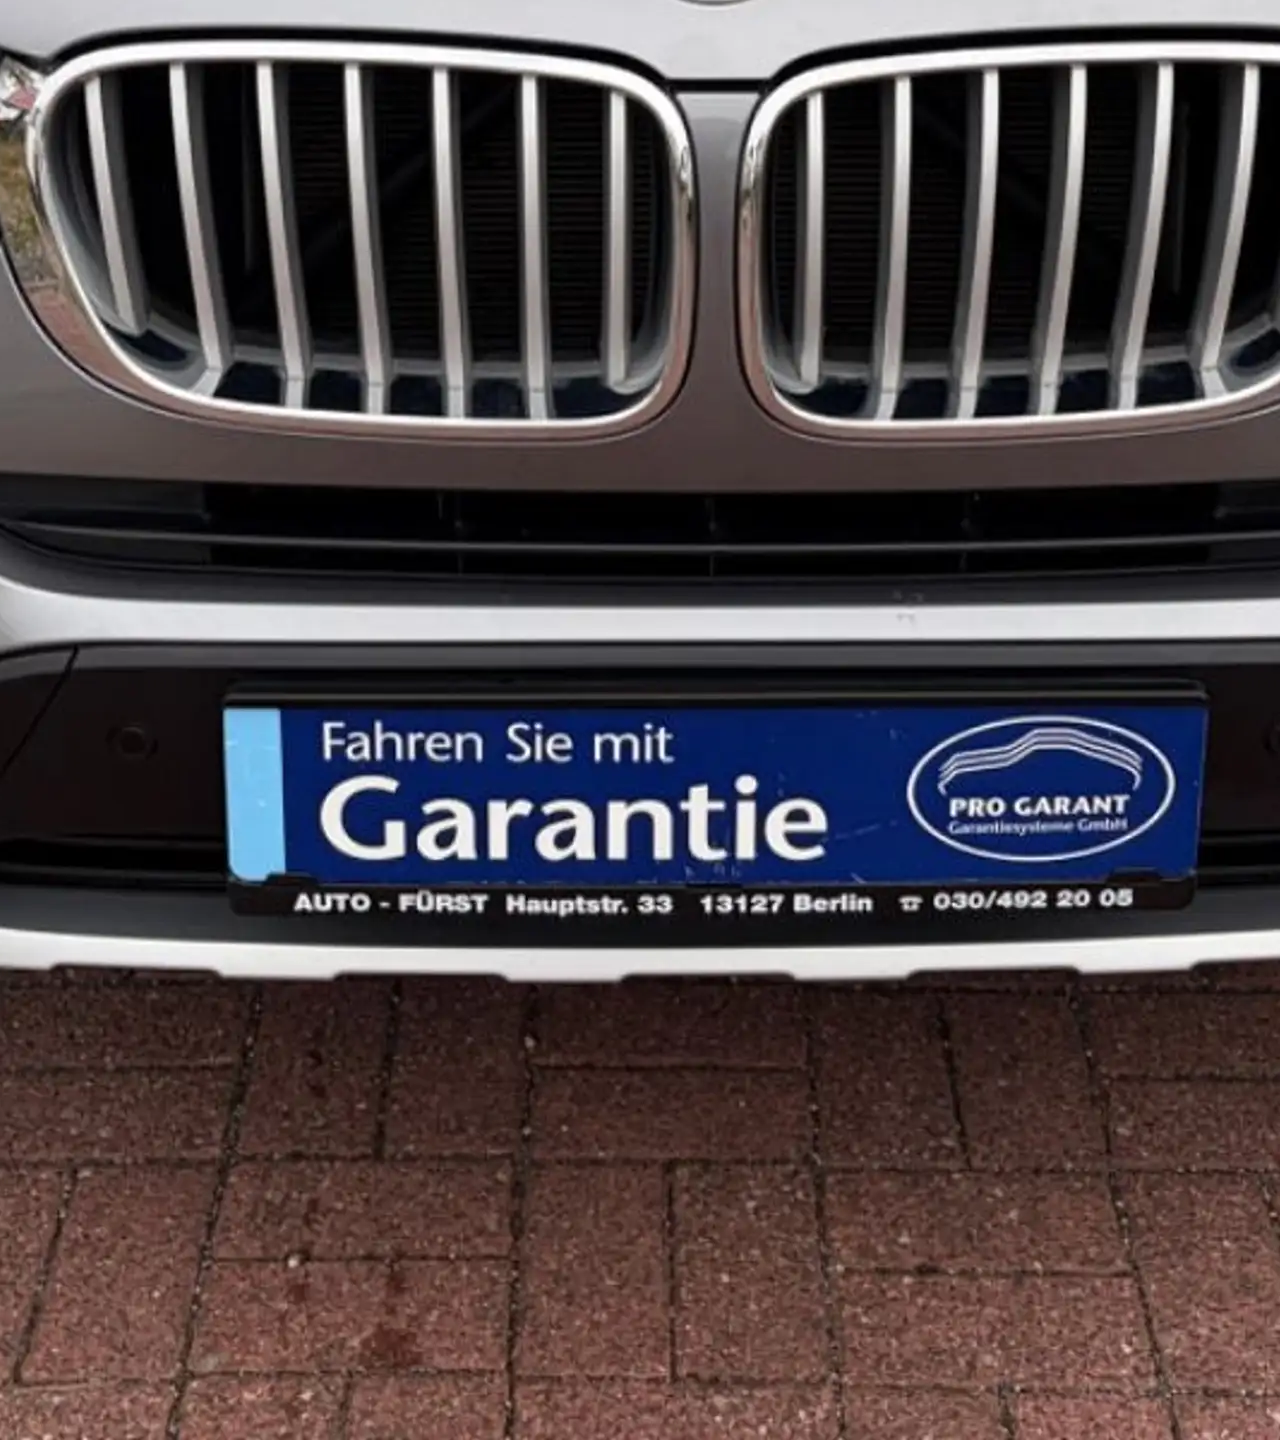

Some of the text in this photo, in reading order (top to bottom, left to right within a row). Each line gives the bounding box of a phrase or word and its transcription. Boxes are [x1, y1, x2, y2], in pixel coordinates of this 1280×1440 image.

[322, 720, 674, 763] Fahren Sie mit
[320, 774, 828, 861] Garantie
[949, 794, 1130, 818] PRO GARANT
[948, 816, 1128, 836] Garantiesysteme GmbH
[293, 892, 372, 913] AUTO
[398, 890, 489, 914] FÜRST
[505, 893, 629, 917] Hauptstr.
[637, 893, 674, 914] 33
[699, 893, 785, 914] 13127
[792, 892, 874, 913] Berlin
[933, 888, 1048, 911] 030/492
[1055, 888, 1091, 909] 20
[1098, 887, 1134, 908] 05
